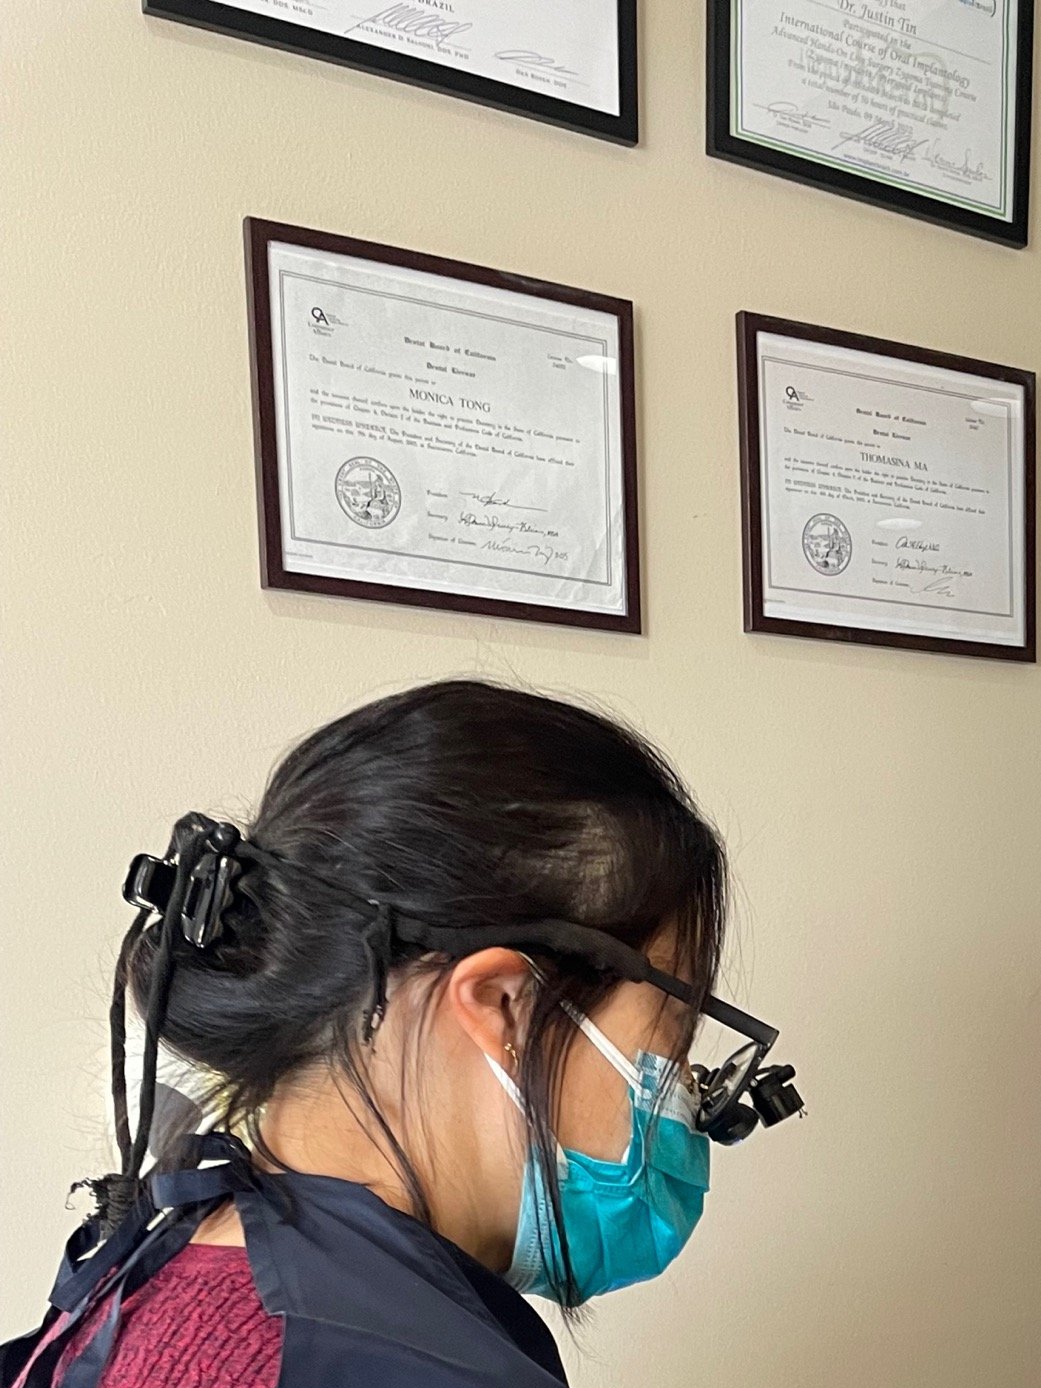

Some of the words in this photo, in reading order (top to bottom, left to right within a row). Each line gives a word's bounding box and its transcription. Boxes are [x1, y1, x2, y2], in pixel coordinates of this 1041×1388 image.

[840, 0, 856, 14] Dr.
[858, 4, 895, 27] Justin
[897, 17, 917, 35] Tin
[780, 11, 843, 42] International
[845, 31, 876, 54] Course
[877, 43, 890, 61] of
[890, 50, 911, 65] Oral
[913, 57, 971, 89] Implantology
[409, 387, 454, 407] MONICA
[460, 397, 491, 413] TONG
[860, 451, 911, 469] THOMASINA
[914, 461, 929, 471] MA
